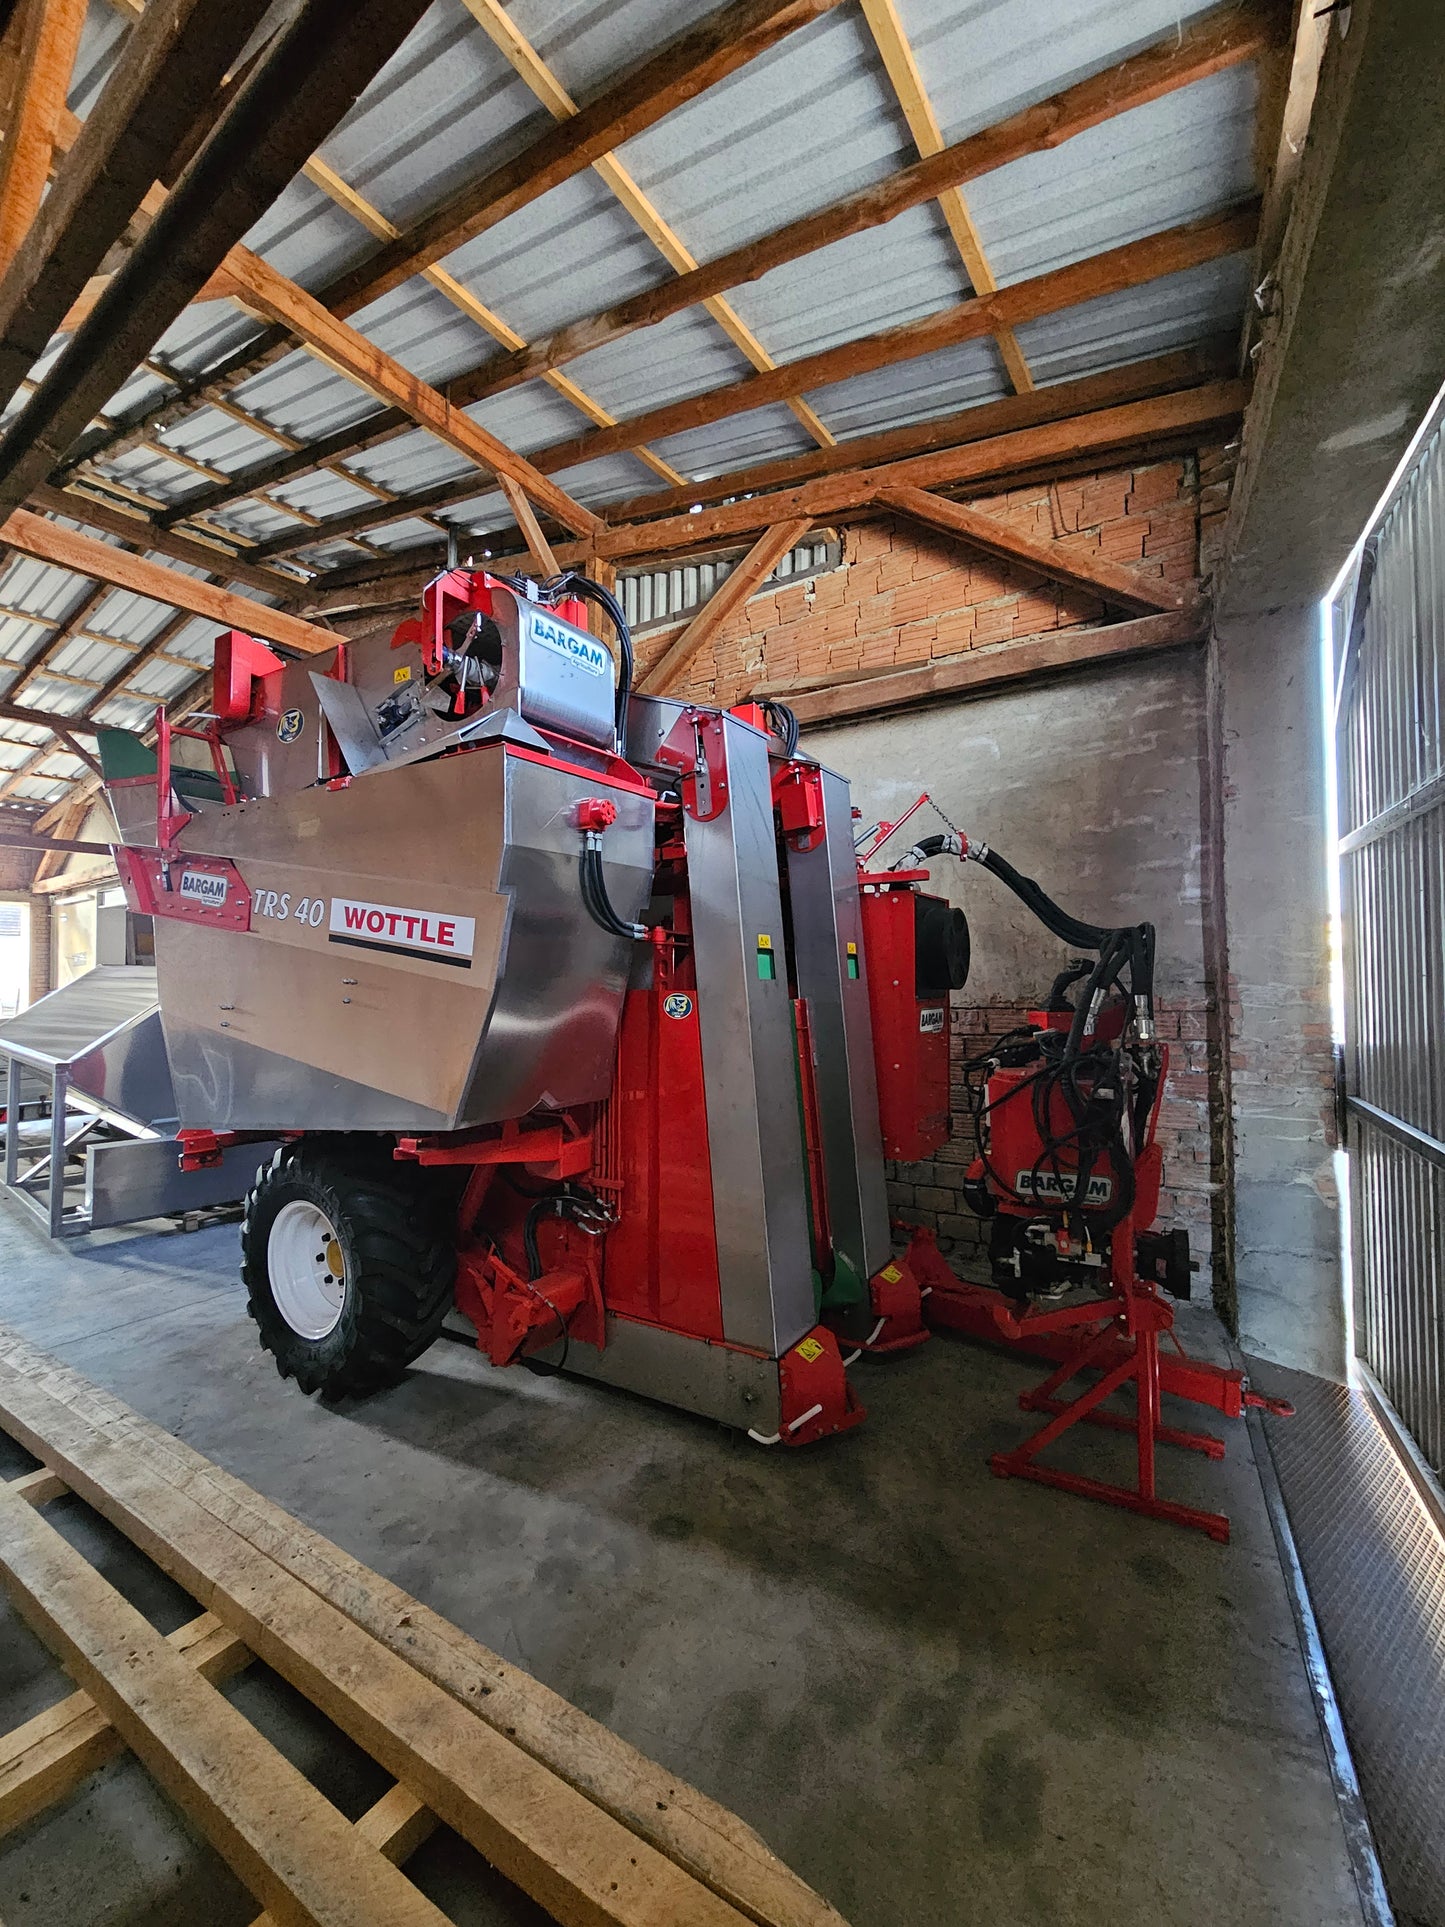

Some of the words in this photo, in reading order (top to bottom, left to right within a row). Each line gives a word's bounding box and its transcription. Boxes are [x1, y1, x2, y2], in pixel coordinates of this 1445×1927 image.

[534, 619, 603, 668] BARGAM
[182, 875, 225, 898] BARGAM
[253, 888, 291, 920] TRS
[294, 897, 325, 928] 40
[344, 905, 456, 947] WOTTLE
[1020, 1174, 1108, 1197] BARGM
